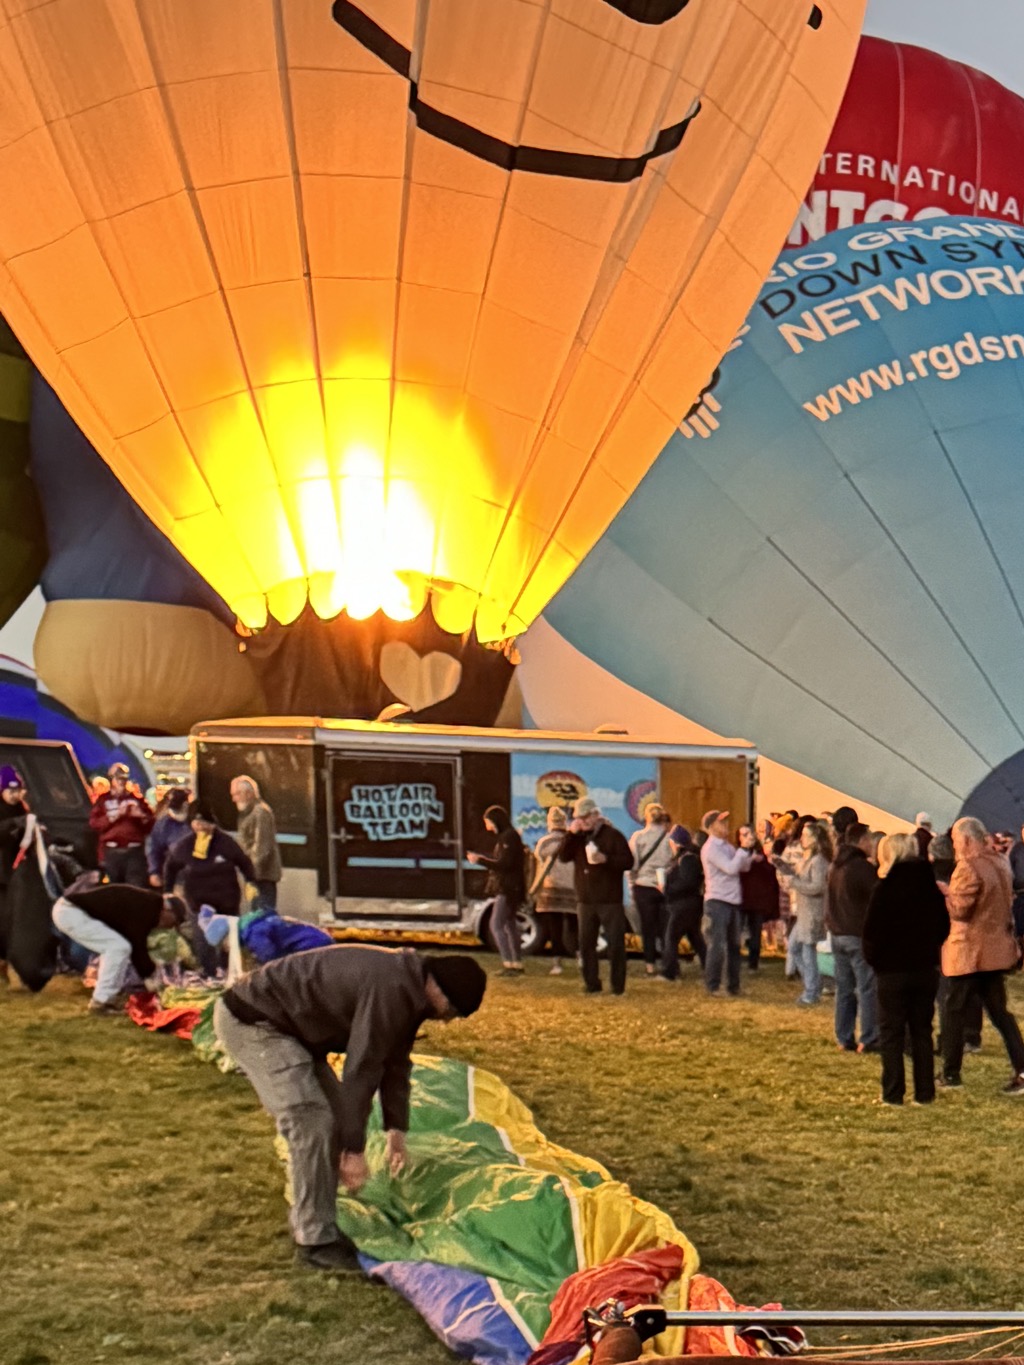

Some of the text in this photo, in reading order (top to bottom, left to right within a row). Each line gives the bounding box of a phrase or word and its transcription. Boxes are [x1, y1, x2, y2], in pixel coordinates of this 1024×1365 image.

[759, 245, 927, 320] DOWN
[354, 784, 435, 803] HOT AIR
[349, 802, 442, 820] BALLOON
[366, 819, 426, 837] TEAM
